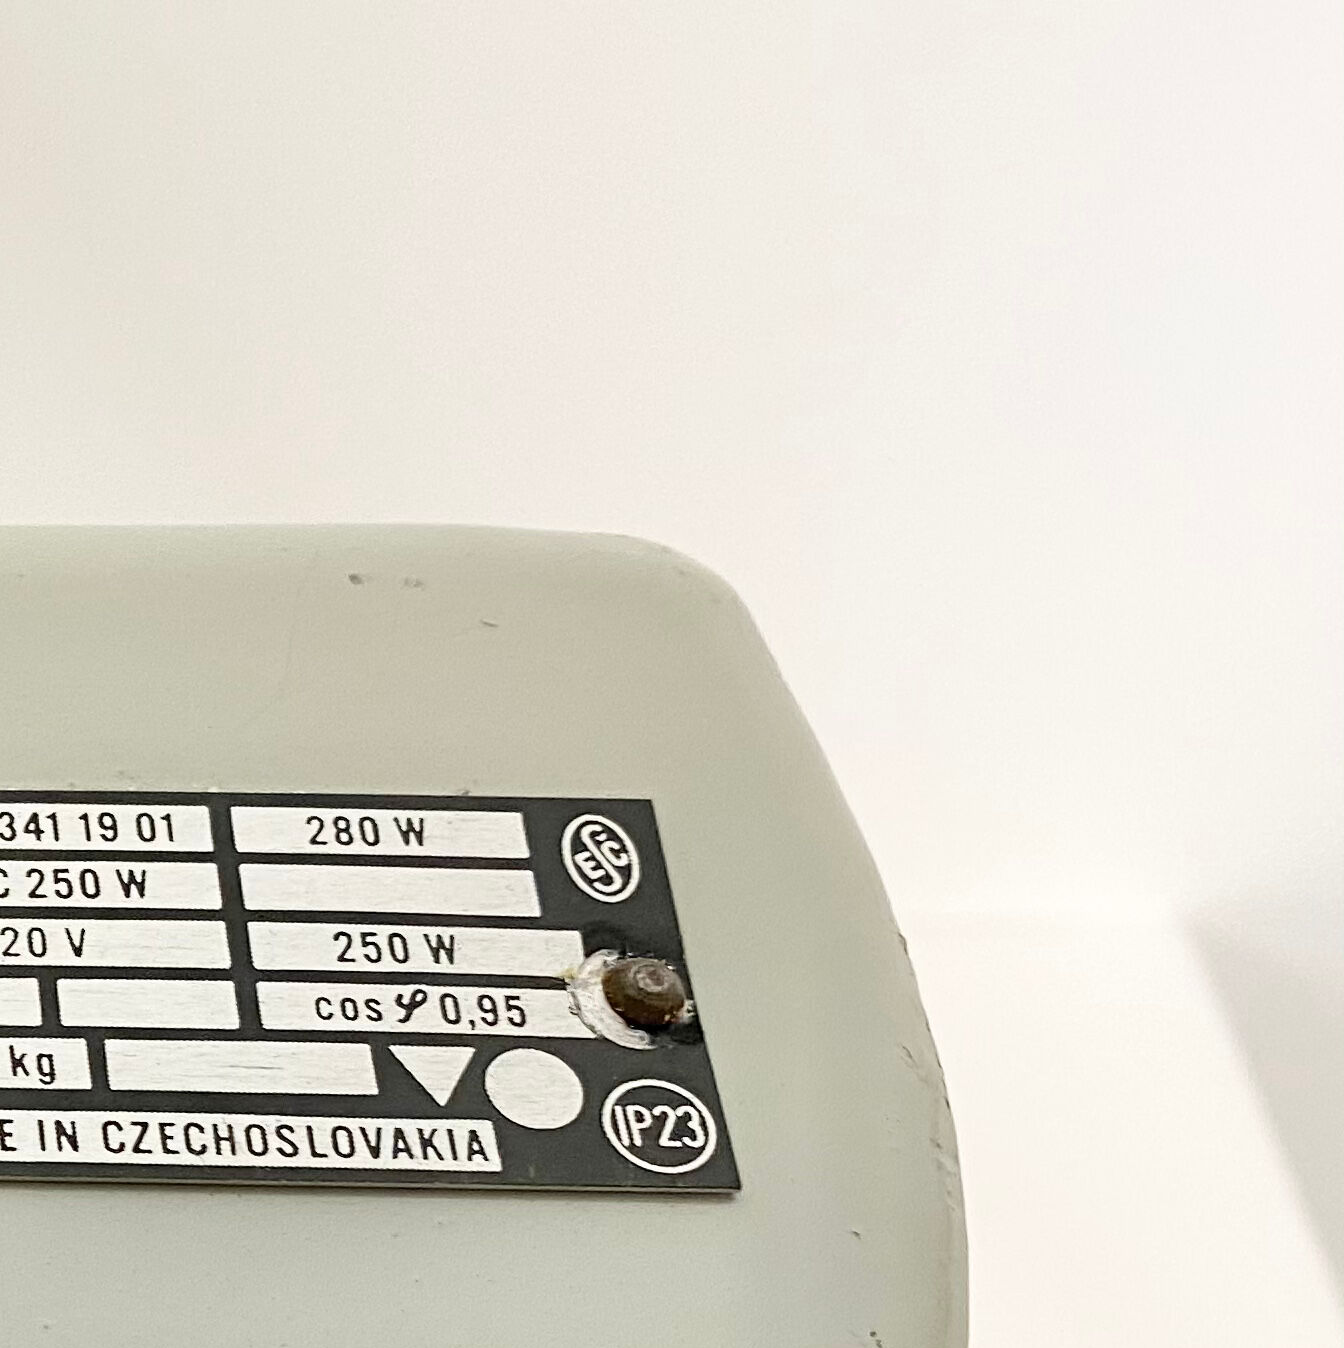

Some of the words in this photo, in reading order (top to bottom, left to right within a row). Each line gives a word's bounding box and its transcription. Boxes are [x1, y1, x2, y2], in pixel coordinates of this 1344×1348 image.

[78, 811, 119, 843] 19
[135, 812, 174, 843] 01
[306, 815, 381, 847] 280
[392, 816, 425, 847] W
[25, 868, 101, 900] 250
[115, 868, 147, 899] W
[64, 927, 86, 958] V
[332, 930, 410, 965] 250
[422, 933, 455, 966] W
[314, 996, 384, 1023] cos
[439, 992, 528, 1031] 0,95
[8, 1044, 57, 1086] kg
[37, 1119, 80, 1153] IN
[101, 1119, 490, 1162] CZECHOSLOVAKIA
[612, 1103, 706, 1150] IP23
